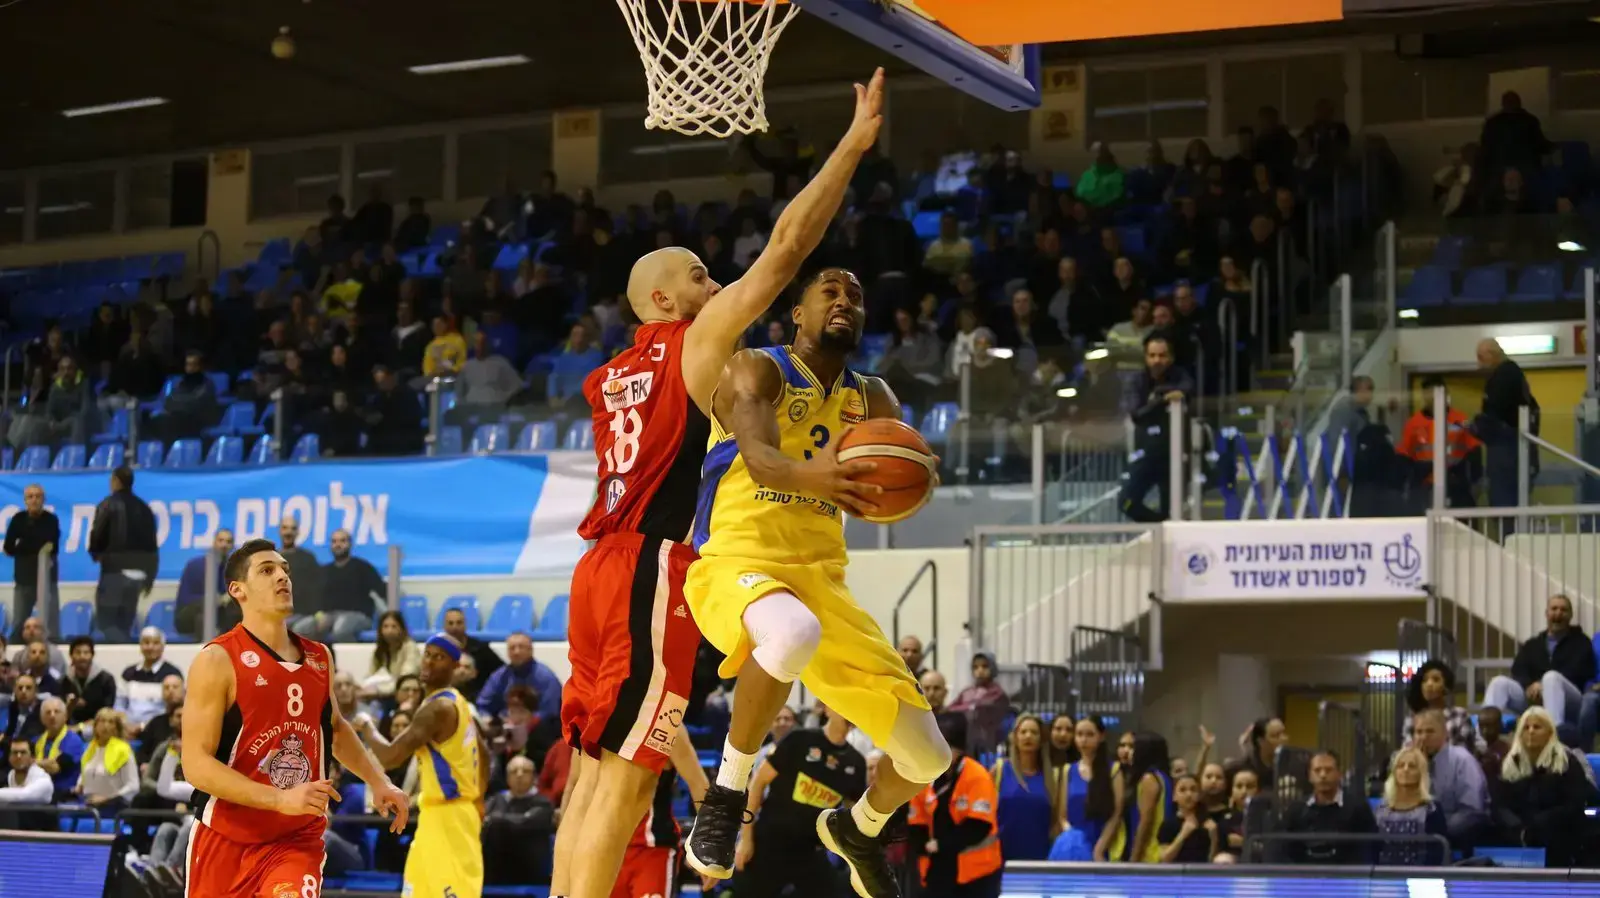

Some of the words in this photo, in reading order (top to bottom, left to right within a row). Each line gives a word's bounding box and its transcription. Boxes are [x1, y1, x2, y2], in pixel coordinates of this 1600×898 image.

[605, 407, 643, 474] 18
[803, 424, 830, 461] 3
[755, 490, 793, 505] טוביה
[1224, 544, 1304, 563] העירונית
[1310, 543, 1373, 561] הרשות
[1230, 569, 1291, 588] אשדוד
[1297, 565, 1367, 587] לספורט
[287, 683, 304, 717] 8
[283, 721, 311, 734] אזורית
[248, 725, 282, 756] הגלבוע
[301, 874, 318, 898] 8
